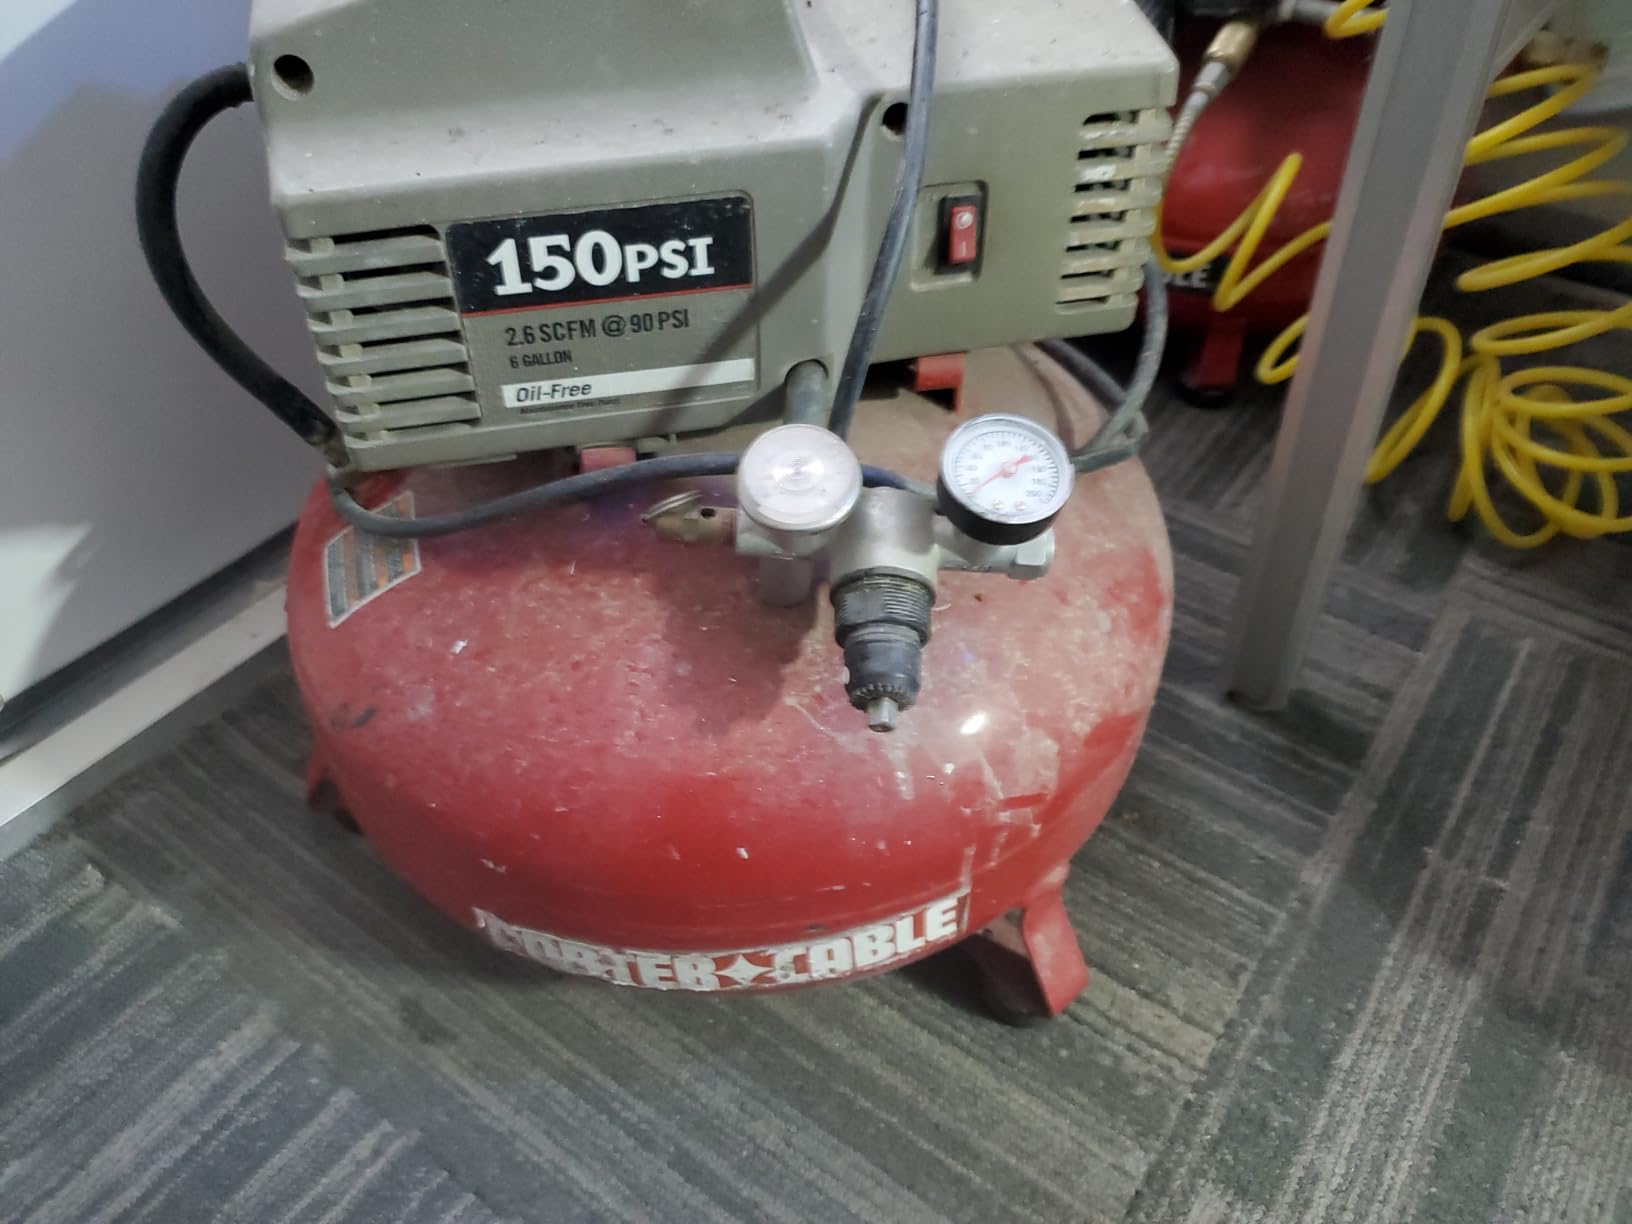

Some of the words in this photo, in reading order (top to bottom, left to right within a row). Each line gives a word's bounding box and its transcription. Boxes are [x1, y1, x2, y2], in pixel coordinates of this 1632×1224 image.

[505, 324, 536, 346] 2.6
[539, 318, 597, 343] SCFM
[602, 315, 626, 337] @
[630, 313, 654, 333] 90
[657, 308, 689, 331] PSI
[510, 355, 519, 369] 6
[522, 349, 573, 367] GALLON
[516, 383, 592, 402] Oil-Free
[774, 896, 960, 984] CABLE
